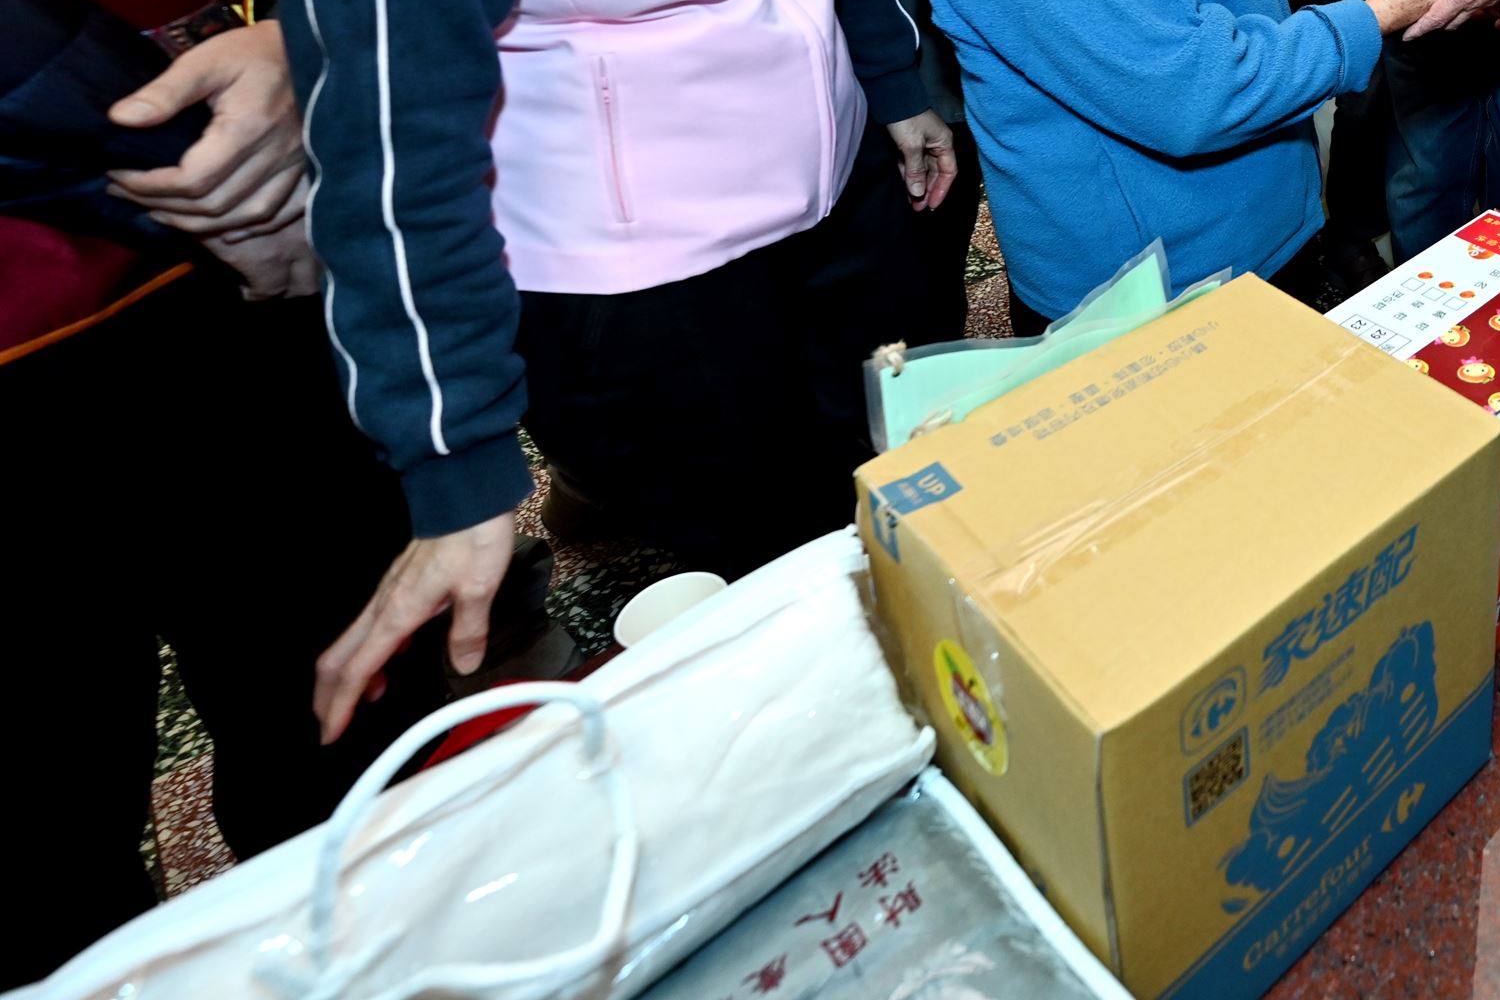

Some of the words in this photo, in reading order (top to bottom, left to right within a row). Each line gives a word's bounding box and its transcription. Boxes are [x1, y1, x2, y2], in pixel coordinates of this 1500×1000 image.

[1350, 319, 1367, 331] 23
[1370, 328, 1387, 340] 29
[917, 473, 947, 497] UP
[1255, 521, 1421, 698] 家速配
[794, 851, 900, 927] 法人
[1242, 833, 1373, 970] Carrefour
